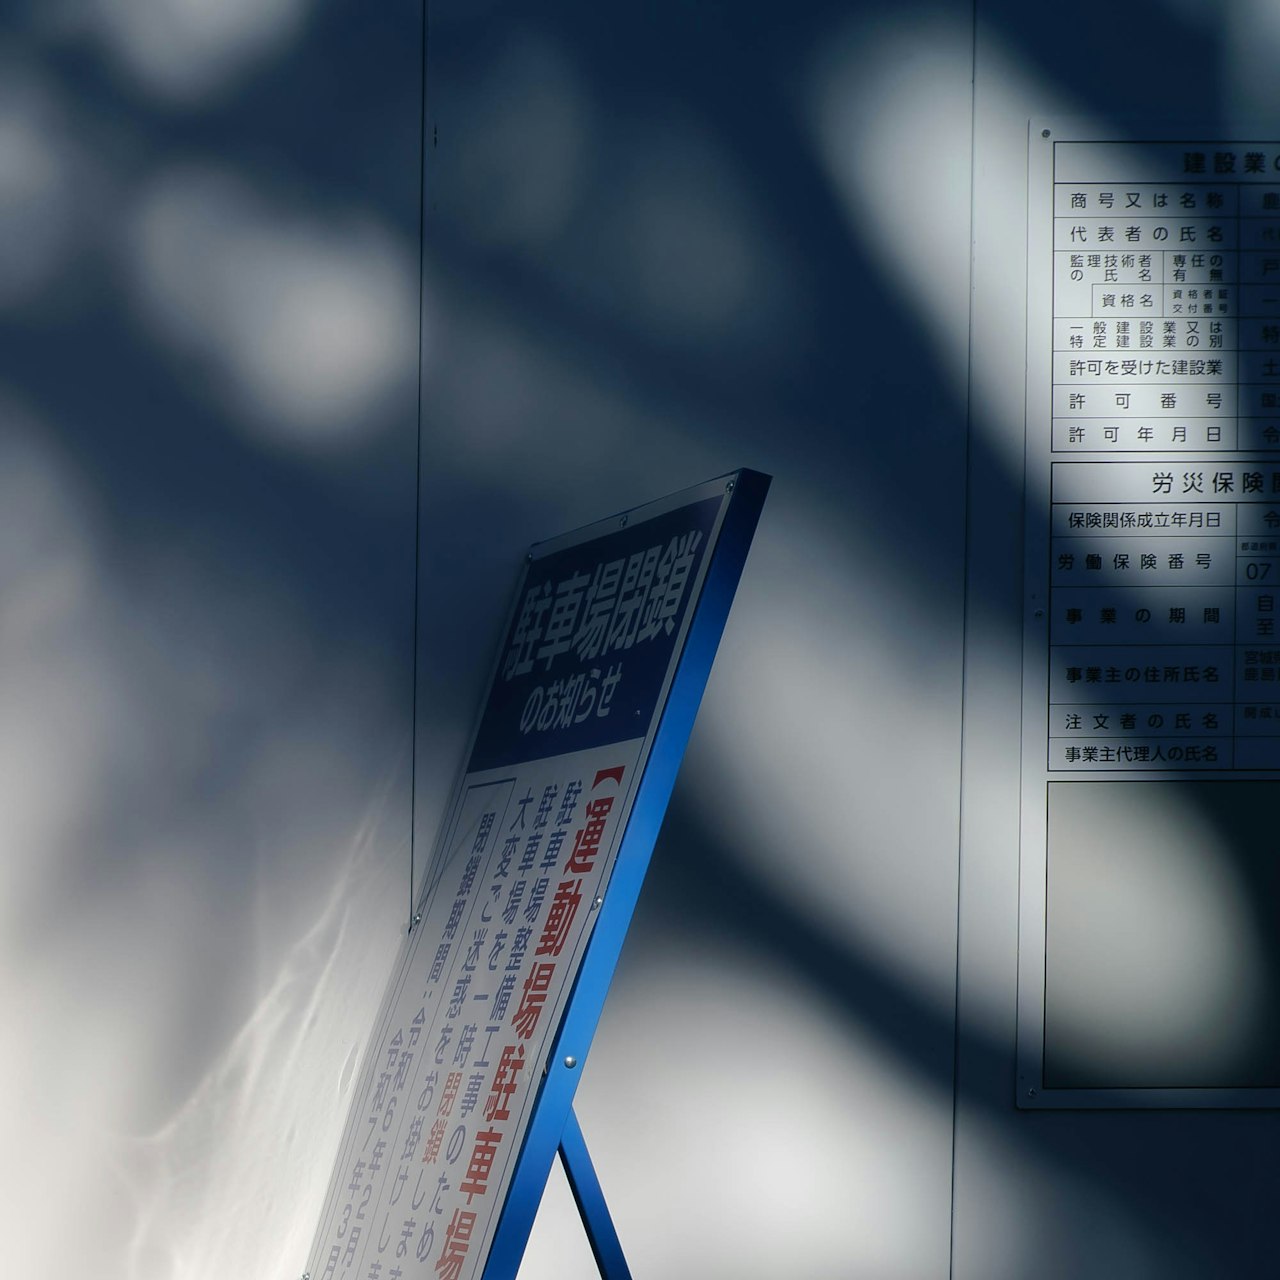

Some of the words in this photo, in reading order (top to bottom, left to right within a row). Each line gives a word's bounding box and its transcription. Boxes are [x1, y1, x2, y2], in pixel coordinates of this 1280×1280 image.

[1183, 151, 1280, 174] 建設業
[1070, 192, 1224, 209] 商号又は名称
[1070, 227, 1223, 243] 代表者の氏名
[1070, 254, 1152, 268] 監理技術者
[1173, 254, 1223, 268] 専任の
[1070, 269, 1152, 282] の氏名
[1173, 269, 1223, 282] 有無
[1101, 293, 1154, 308] 資格名
[1172, 303, 1228, 314] 交付番号
[1070, 321, 1223, 334] 一般建設業又は
[1070, 335, 1223, 349] 特定建設業の別
[1070, 360, 1223, 376] 許可を受けた建設業
[1069, 393, 1223, 410] 許可番号
[1069, 427, 1221, 443] 許可年月日
[1068, 512, 1221, 528] 保険関係成立年月日
[1058, 553, 1212, 570] 労働保険番号
[1246, 563, 1272, 580] 07
[502, 530, 704, 682] 駐車場閉鎖
[1065, 608, 1220, 624] 事業の期間
[1065, 667, 1219, 683] 事業主の住所氏名
[519, 662, 623, 736] のお知らせ
[1065, 713, 1219, 730] 注文者の氏名
[1065, 746, 1218, 763] 事業主代理人の氏名
[416, 779, 582, 1263] 駐車場整備工事のため
